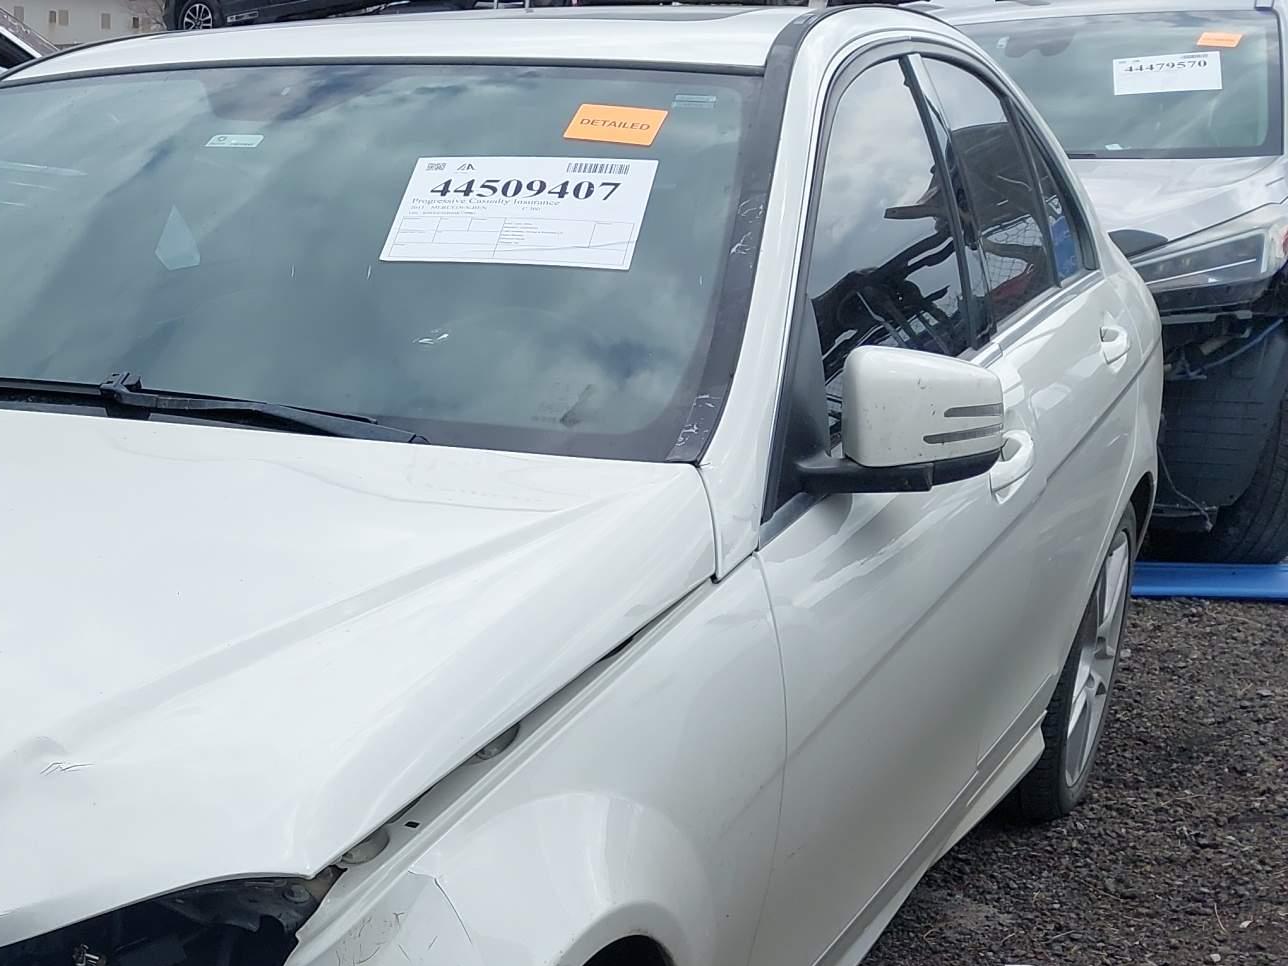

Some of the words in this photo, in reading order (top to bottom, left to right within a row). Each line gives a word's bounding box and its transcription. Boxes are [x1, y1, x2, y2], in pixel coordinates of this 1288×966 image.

[1124, 59, 1208, 72] 44479570
[580, 118, 650, 131] DETAILED
[430, 178, 621, 201] 44509407
